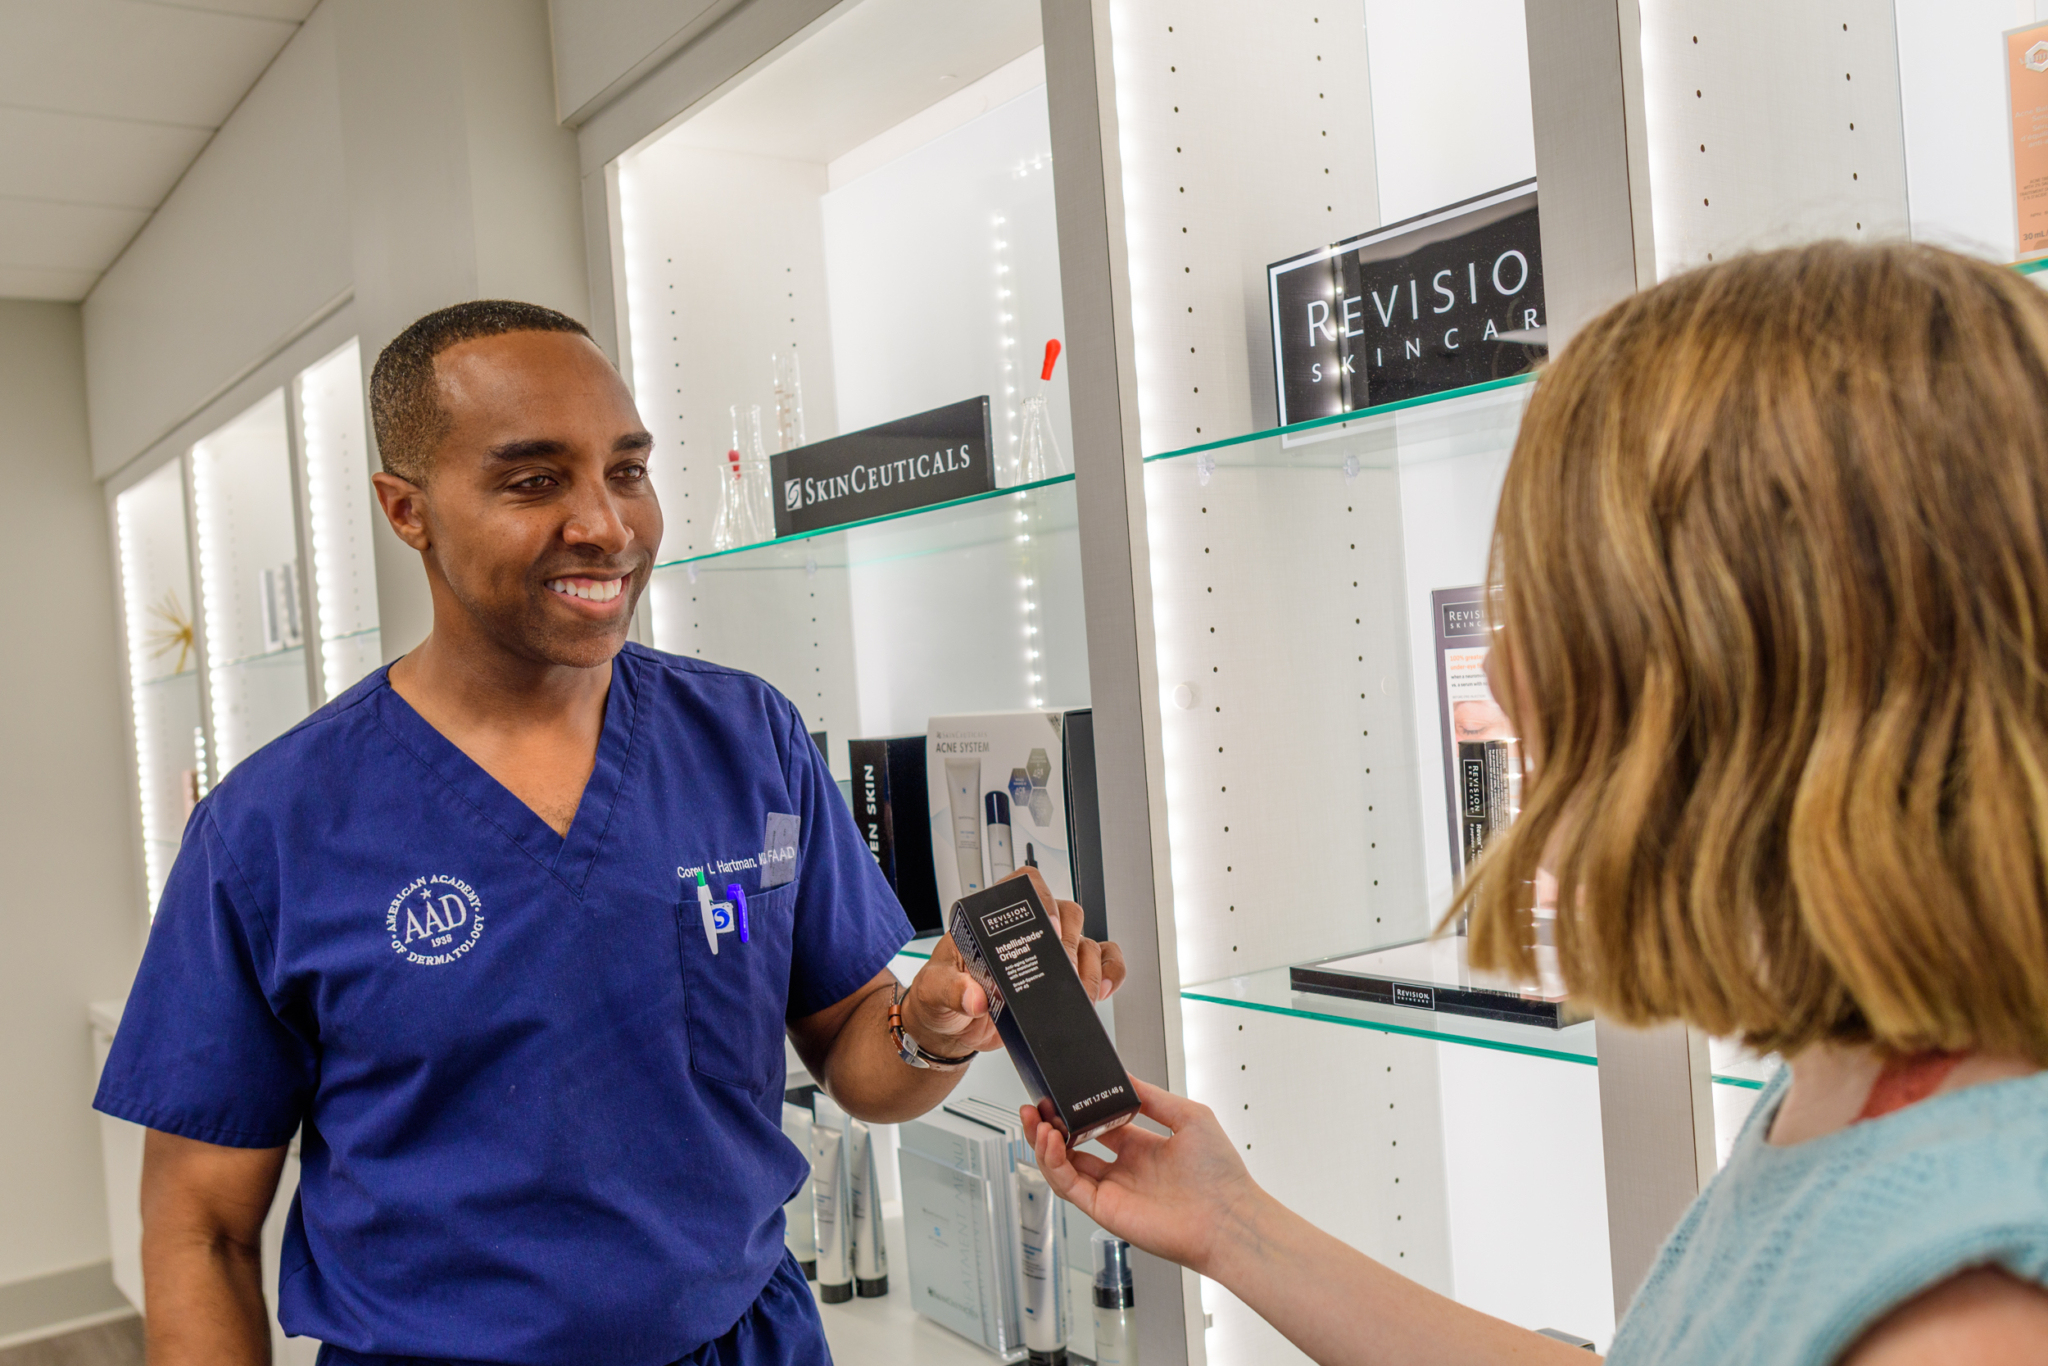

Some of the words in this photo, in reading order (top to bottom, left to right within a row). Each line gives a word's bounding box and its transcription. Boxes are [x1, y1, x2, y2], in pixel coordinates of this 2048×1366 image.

[1307, 249, 1529, 347] REVISIO
[1311, 308, 1540, 383] SKINCAR
[1449, 610, 1485, 621] REVISI
[1450, 621, 1482, 630] SKINC
[936, 742, 957, 753] ACNE
[959, 741, 990, 753] SYSTEM
[863, 764, 877, 816] SKIN
[1472, 765, 1481, 812] REVISION
[677, 865, 704, 879] Corey
[386, 876, 427, 932] AMERICAN
[430, 874, 481, 907] ACADEMY
[987, 906, 1027, 926] REVISION
[405, 893, 467, 944] AAD
[391, 940, 408, 954] OF
[406, 914, 485, 966] DERMATOLOGY
[431, 933, 453, 948] 1938
[999, 943, 1031, 962] Original
[1072, 1101, 1084, 1112] NET
[1082, 1097, 1093, 1107] WT
[1092, 1093, 1101, 1103] 1.7
[1100, 1090, 1110, 1100] OZ
[1111, 1086, 1120, 1094] 48
[1118, 1085, 1125, 1094] g
